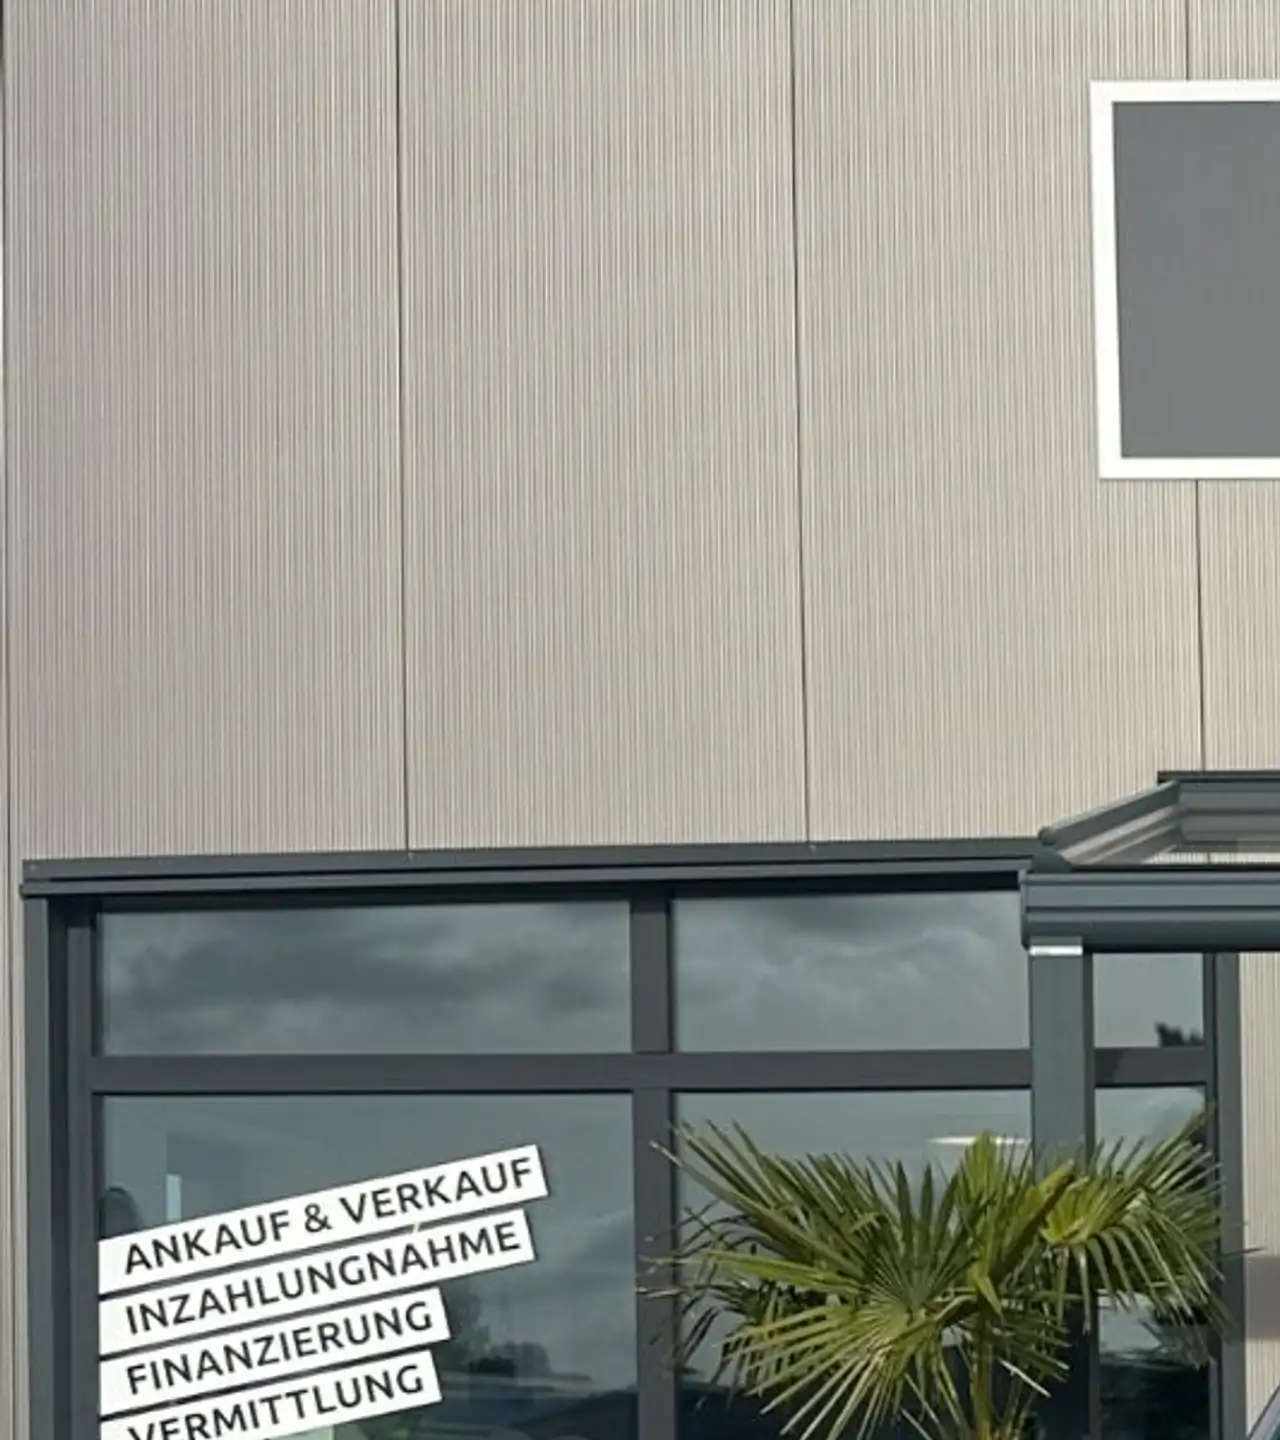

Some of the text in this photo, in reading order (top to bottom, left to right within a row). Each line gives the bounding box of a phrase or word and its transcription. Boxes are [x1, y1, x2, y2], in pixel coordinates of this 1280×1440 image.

[124, 1156, 533, 1276] ANKAUF & VERKAUF
[126, 1219, 523, 1336] INZAHLUNGNAHME
[126, 1300, 434, 1395] FINANZIERUNG
